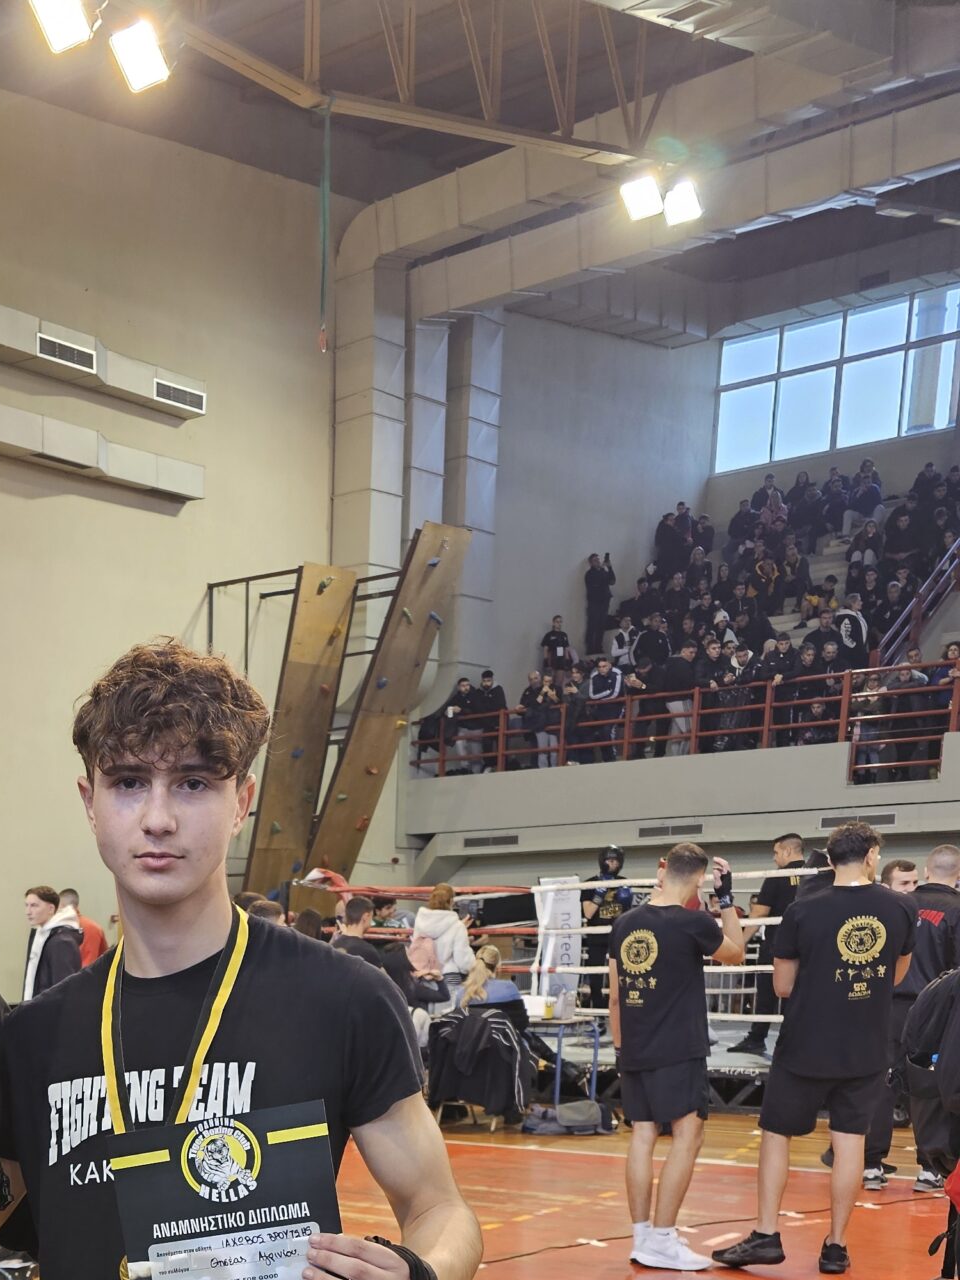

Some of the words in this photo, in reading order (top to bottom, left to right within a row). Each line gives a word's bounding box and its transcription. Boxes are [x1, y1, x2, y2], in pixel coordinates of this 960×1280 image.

[48, 1068, 166, 1167] FIGHTNG
[199, 1176, 258, 1203] HELLAS
[153, 1211, 246, 1239] ΑΝΑΜΝΗΣΤΙΚΟ
[248, 1201, 311, 1225] ΔΙΠΛΩΜΑ
[259, 1273, 279, 1280] GOOD
